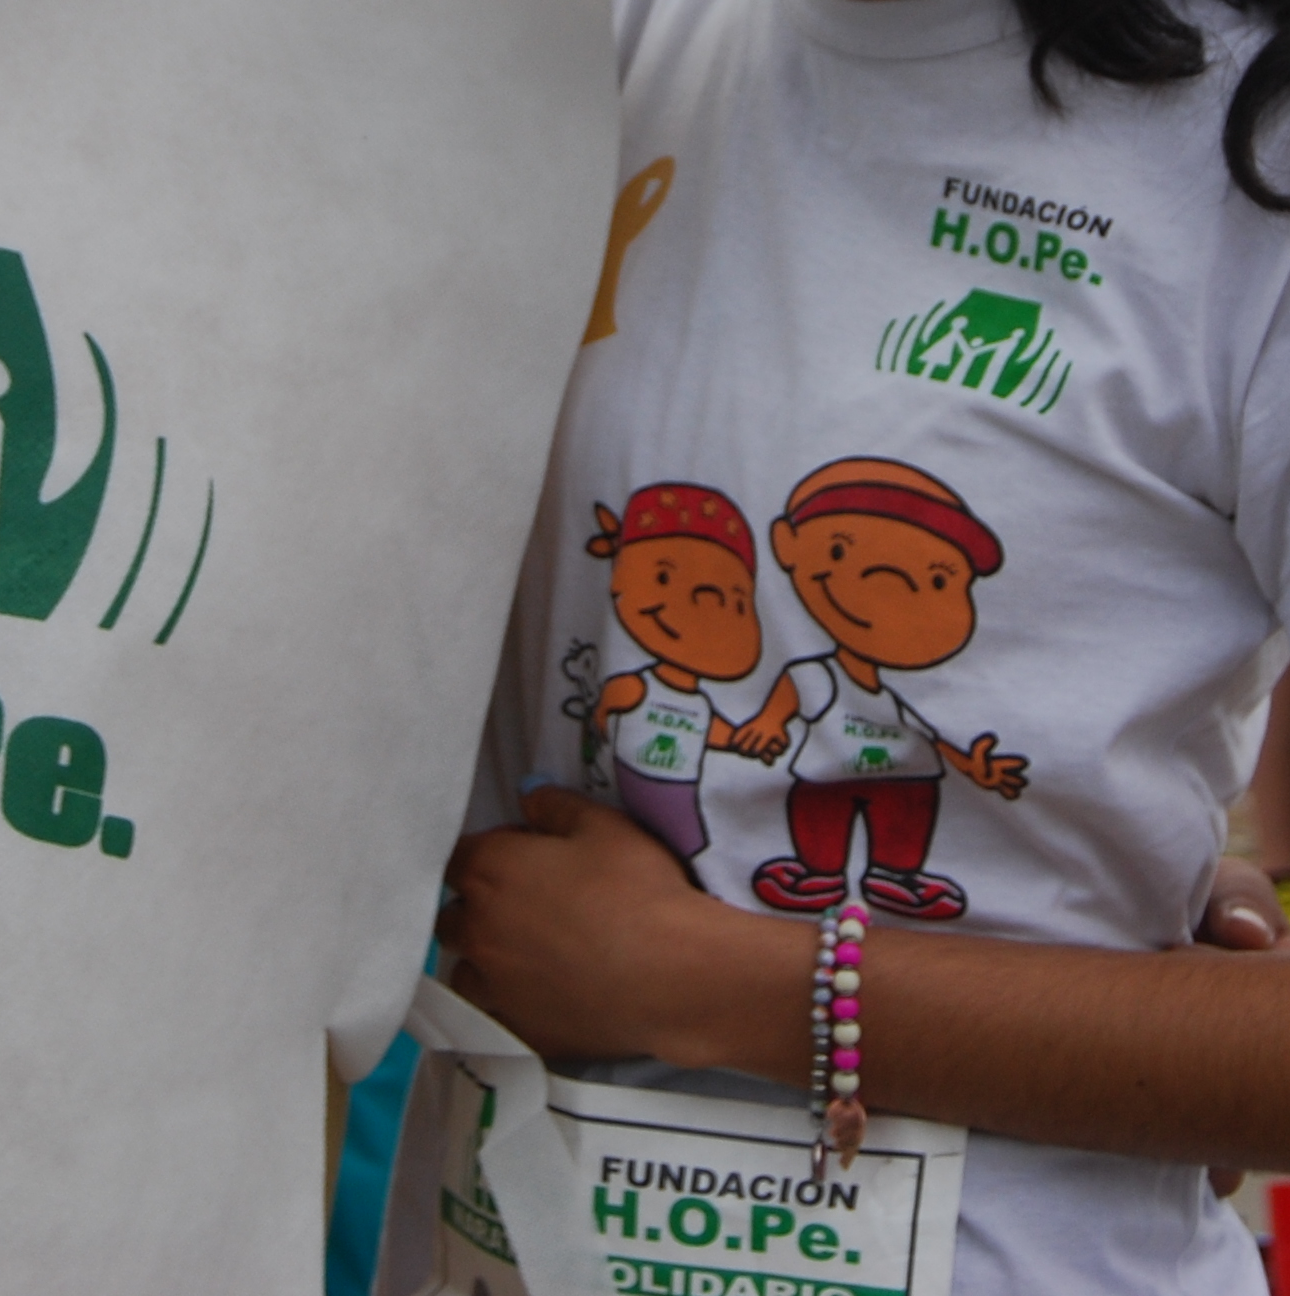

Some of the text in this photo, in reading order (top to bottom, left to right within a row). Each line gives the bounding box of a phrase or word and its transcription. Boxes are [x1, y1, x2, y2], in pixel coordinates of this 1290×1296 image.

[930, 206, 1103, 287] H.O.Pe.
[942, 176, 1113, 238] FUNDACIÓN
[593, 1185, 862, 1266] H.O.Pe.
